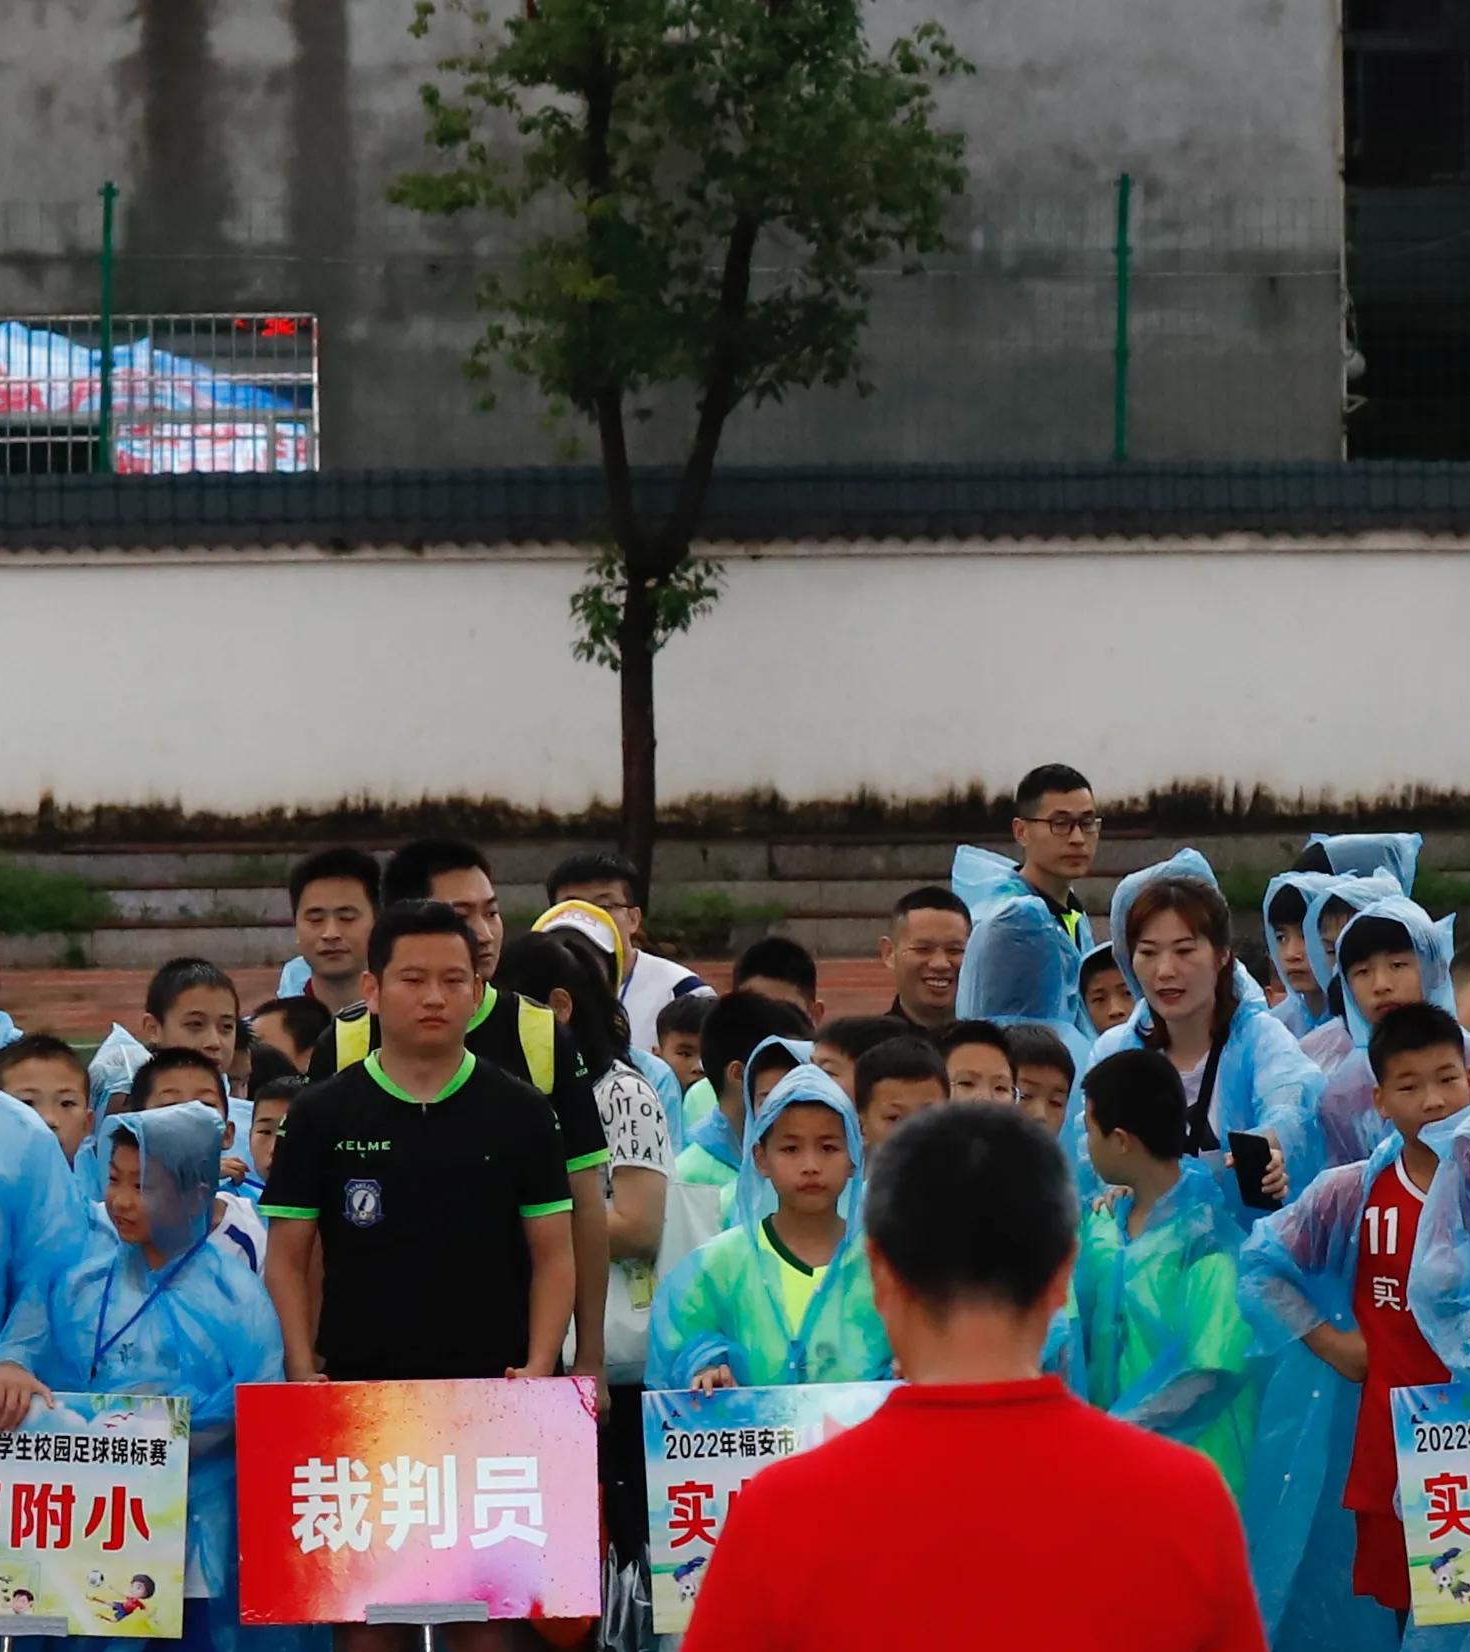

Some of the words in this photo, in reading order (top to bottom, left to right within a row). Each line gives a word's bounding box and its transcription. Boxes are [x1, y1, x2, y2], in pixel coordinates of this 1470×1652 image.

[1365, 1206, 1398, 1255] 11
[1373, 1276, 1411, 1311] 实
[291, 1455, 548, 1554] 裁判员
